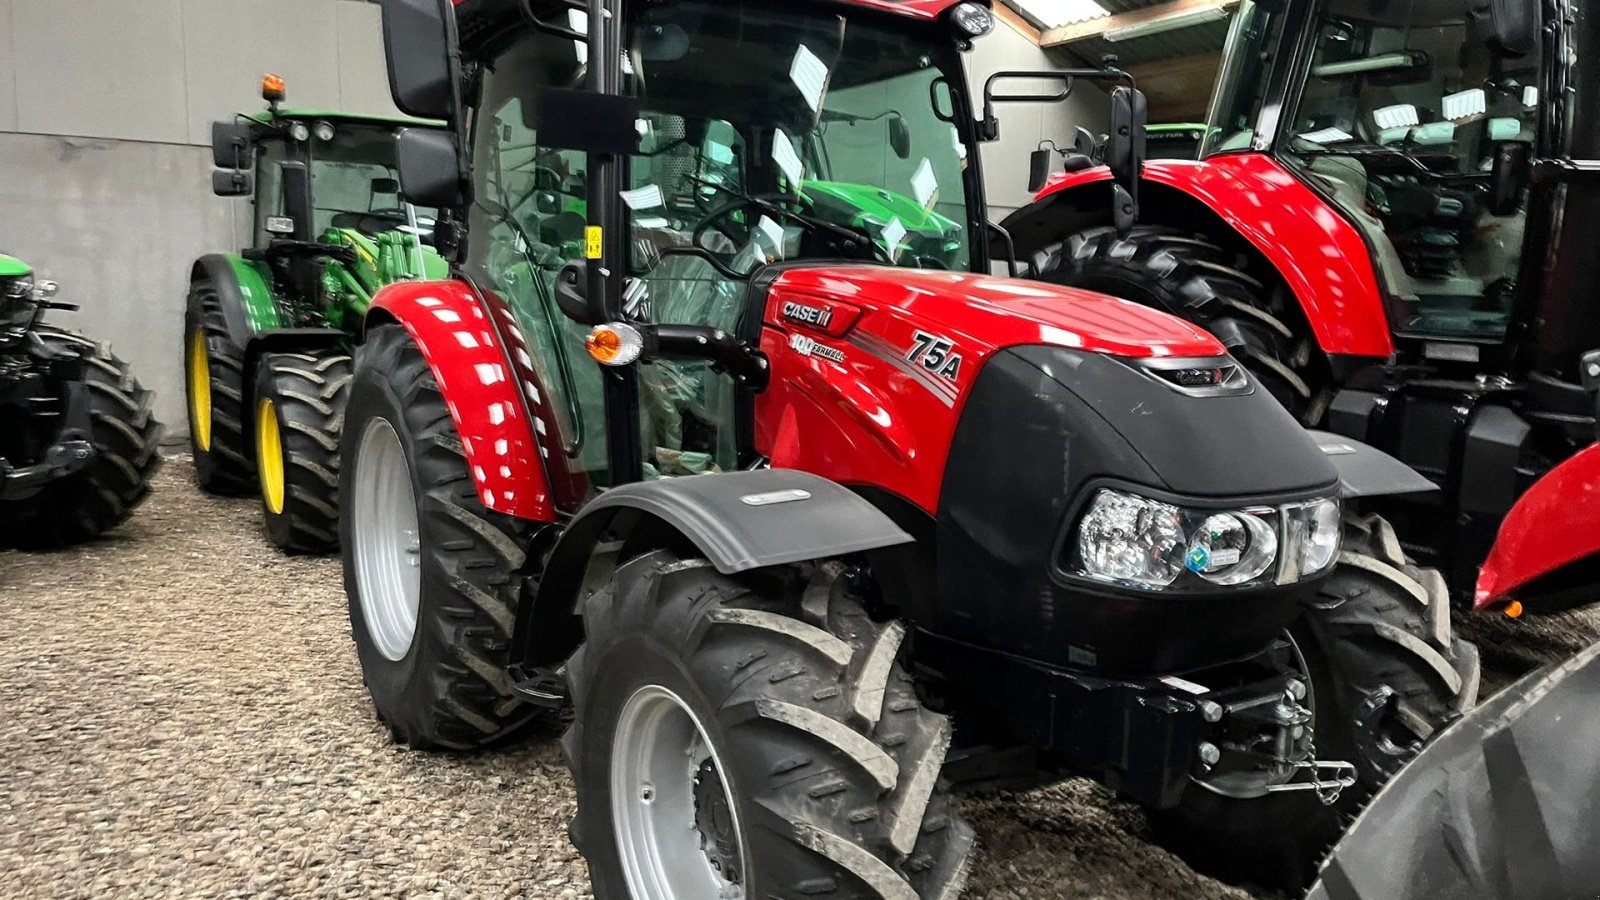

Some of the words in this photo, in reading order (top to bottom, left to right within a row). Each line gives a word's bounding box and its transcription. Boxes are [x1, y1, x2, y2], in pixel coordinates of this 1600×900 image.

[783, 301, 819, 323] CASE
[811, 342, 845, 362] FARMALL
[905, 329, 961, 382] 75A
